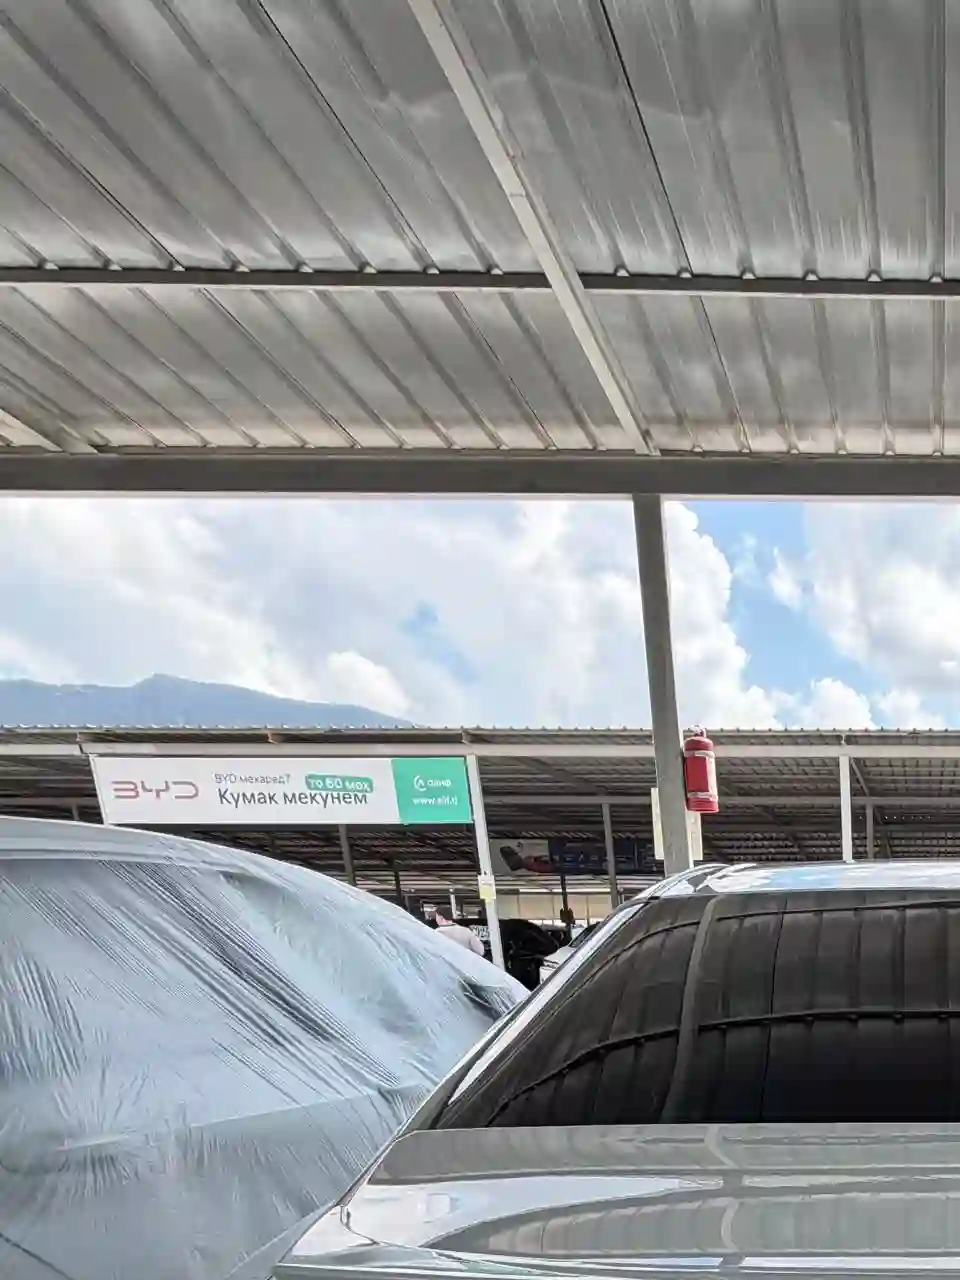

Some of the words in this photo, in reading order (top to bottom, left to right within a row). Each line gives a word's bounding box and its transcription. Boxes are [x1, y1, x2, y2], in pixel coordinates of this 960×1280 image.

[214, 773, 237, 784] BYD
[325, 777, 343, 789] 60
[111, 780, 199, 799] BYD
[283, 791, 367, 808] мекунем
